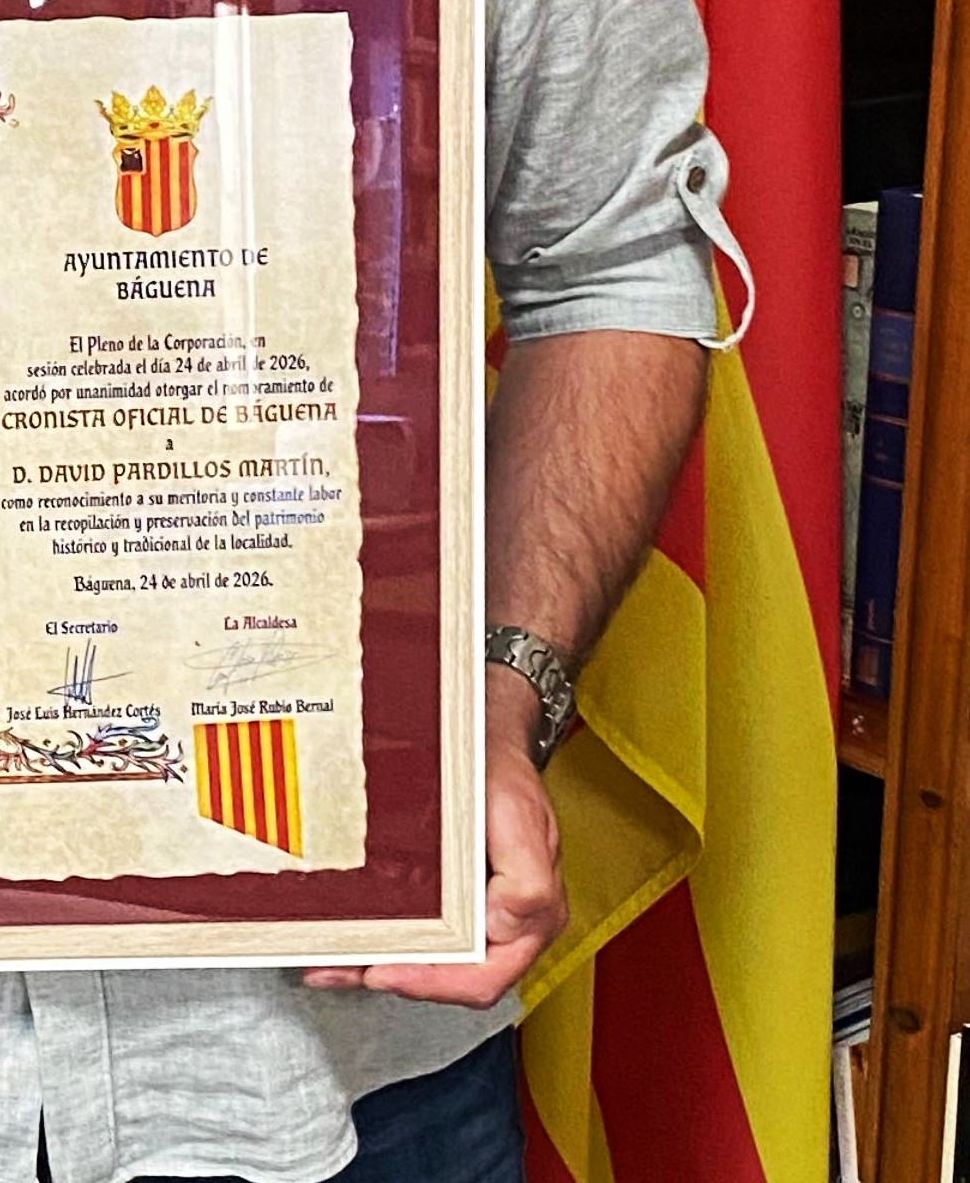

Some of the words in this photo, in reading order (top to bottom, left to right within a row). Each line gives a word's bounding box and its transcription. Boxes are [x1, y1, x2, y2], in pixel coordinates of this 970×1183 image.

[64, 249, 233, 276] AYUNTAMIENTO
[242, 247, 269, 265] DE
[117, 276, 216, 300] BÁGUENA
[69, 336, 83, 353] El
[88, 335, 124, 355] Pleno
[129, 336, 144, 351] de
[148, 335, 159, 351] la
[164, 331, 247, 353] Corporación,
[27, 361, 66, 378] sesión
[71, 361, 131, 376] celebrada
[136, 360, 147, 375] el
[151, 359, 171, 374] día
[175, 359, 192, 373] 24
[198, 358, 212, 373] de
[217, 356, 246, 372] abril
[270, 355, 310, 373] 2026,
[4, 385, 47, 402] acordó
[51, 386, 72, 403] por
[76, 383, 151, 400] unanimidad
[155, 383, 203, 401] otorgar
[208, 382, 219, 396] el
[319, 377, 334, 393] de
[2, 408, 106, 430] CRONISTA
[114, 406, 194, 429] OFICIAL
[202, 405, 228, 424] DE
[236, 401, 338, 424] BÁGUENA
[165, 438, 174, 451] a
[13, 466, 32, 484] D.
[39, 464, 105, 483] DAVID
[113, 460, 231, 485] PARDILLOS
[239, 456, 331, 478] MARTÍN,
[1, 496, 33, 511] como
[38, 490, 131, 508] reconocimiento
[137, 494, 144, 506] a
[148, 492, 164, 506] su
[168, 488, 226, 505] meritoria
[231, 489, 239, 506] y
[243, 487, 304, 503] constante
[309, 485, 342, 501] labor
[20, 519, 34, 533] en
[39, 516, 50, 532] la
[55, 512, 130, 532] recopilación
[134, 515, 142, 531] y
[147, 512, 228, 532] preservación
[232, 511, 250, 526] del
[255, 510, 325, 529] patrimonio
[52, 538, 107, 555] histórico
[112, 539, 119, 556] y
[124, 536, 191, 552] tradicional
[196, 536, 210, 550] de
[214, 535, 226, 549] la
[231, 534, 293, 549] localidad.
[74, 576, 136, 594] Báguena,
[140, 574, 158, 589] 24
[162, 573, 176, 588] de
[180, 573, 210, 588] abril
[214, 572, 229, 586] de
[233, 571, 274, 587] 2026.
[45, 621, 57, 635] El
[59, 621, 118, 635] Secretario
[224, 617, 239, 631] La
[243, 615, 297, 630] Alcaldesa
[6, 704, 32, 722] José
[35, 704, 60, 720] Luis
[64, 704, 122, 720] Hernández
[126, 702, 161, 719] Cortés
[191, 700, 227, 716] María
[230, 700, 256, 717] José
[260, 699, 292, 715] Rubio
[296, 698, 334, 713] Bernal
